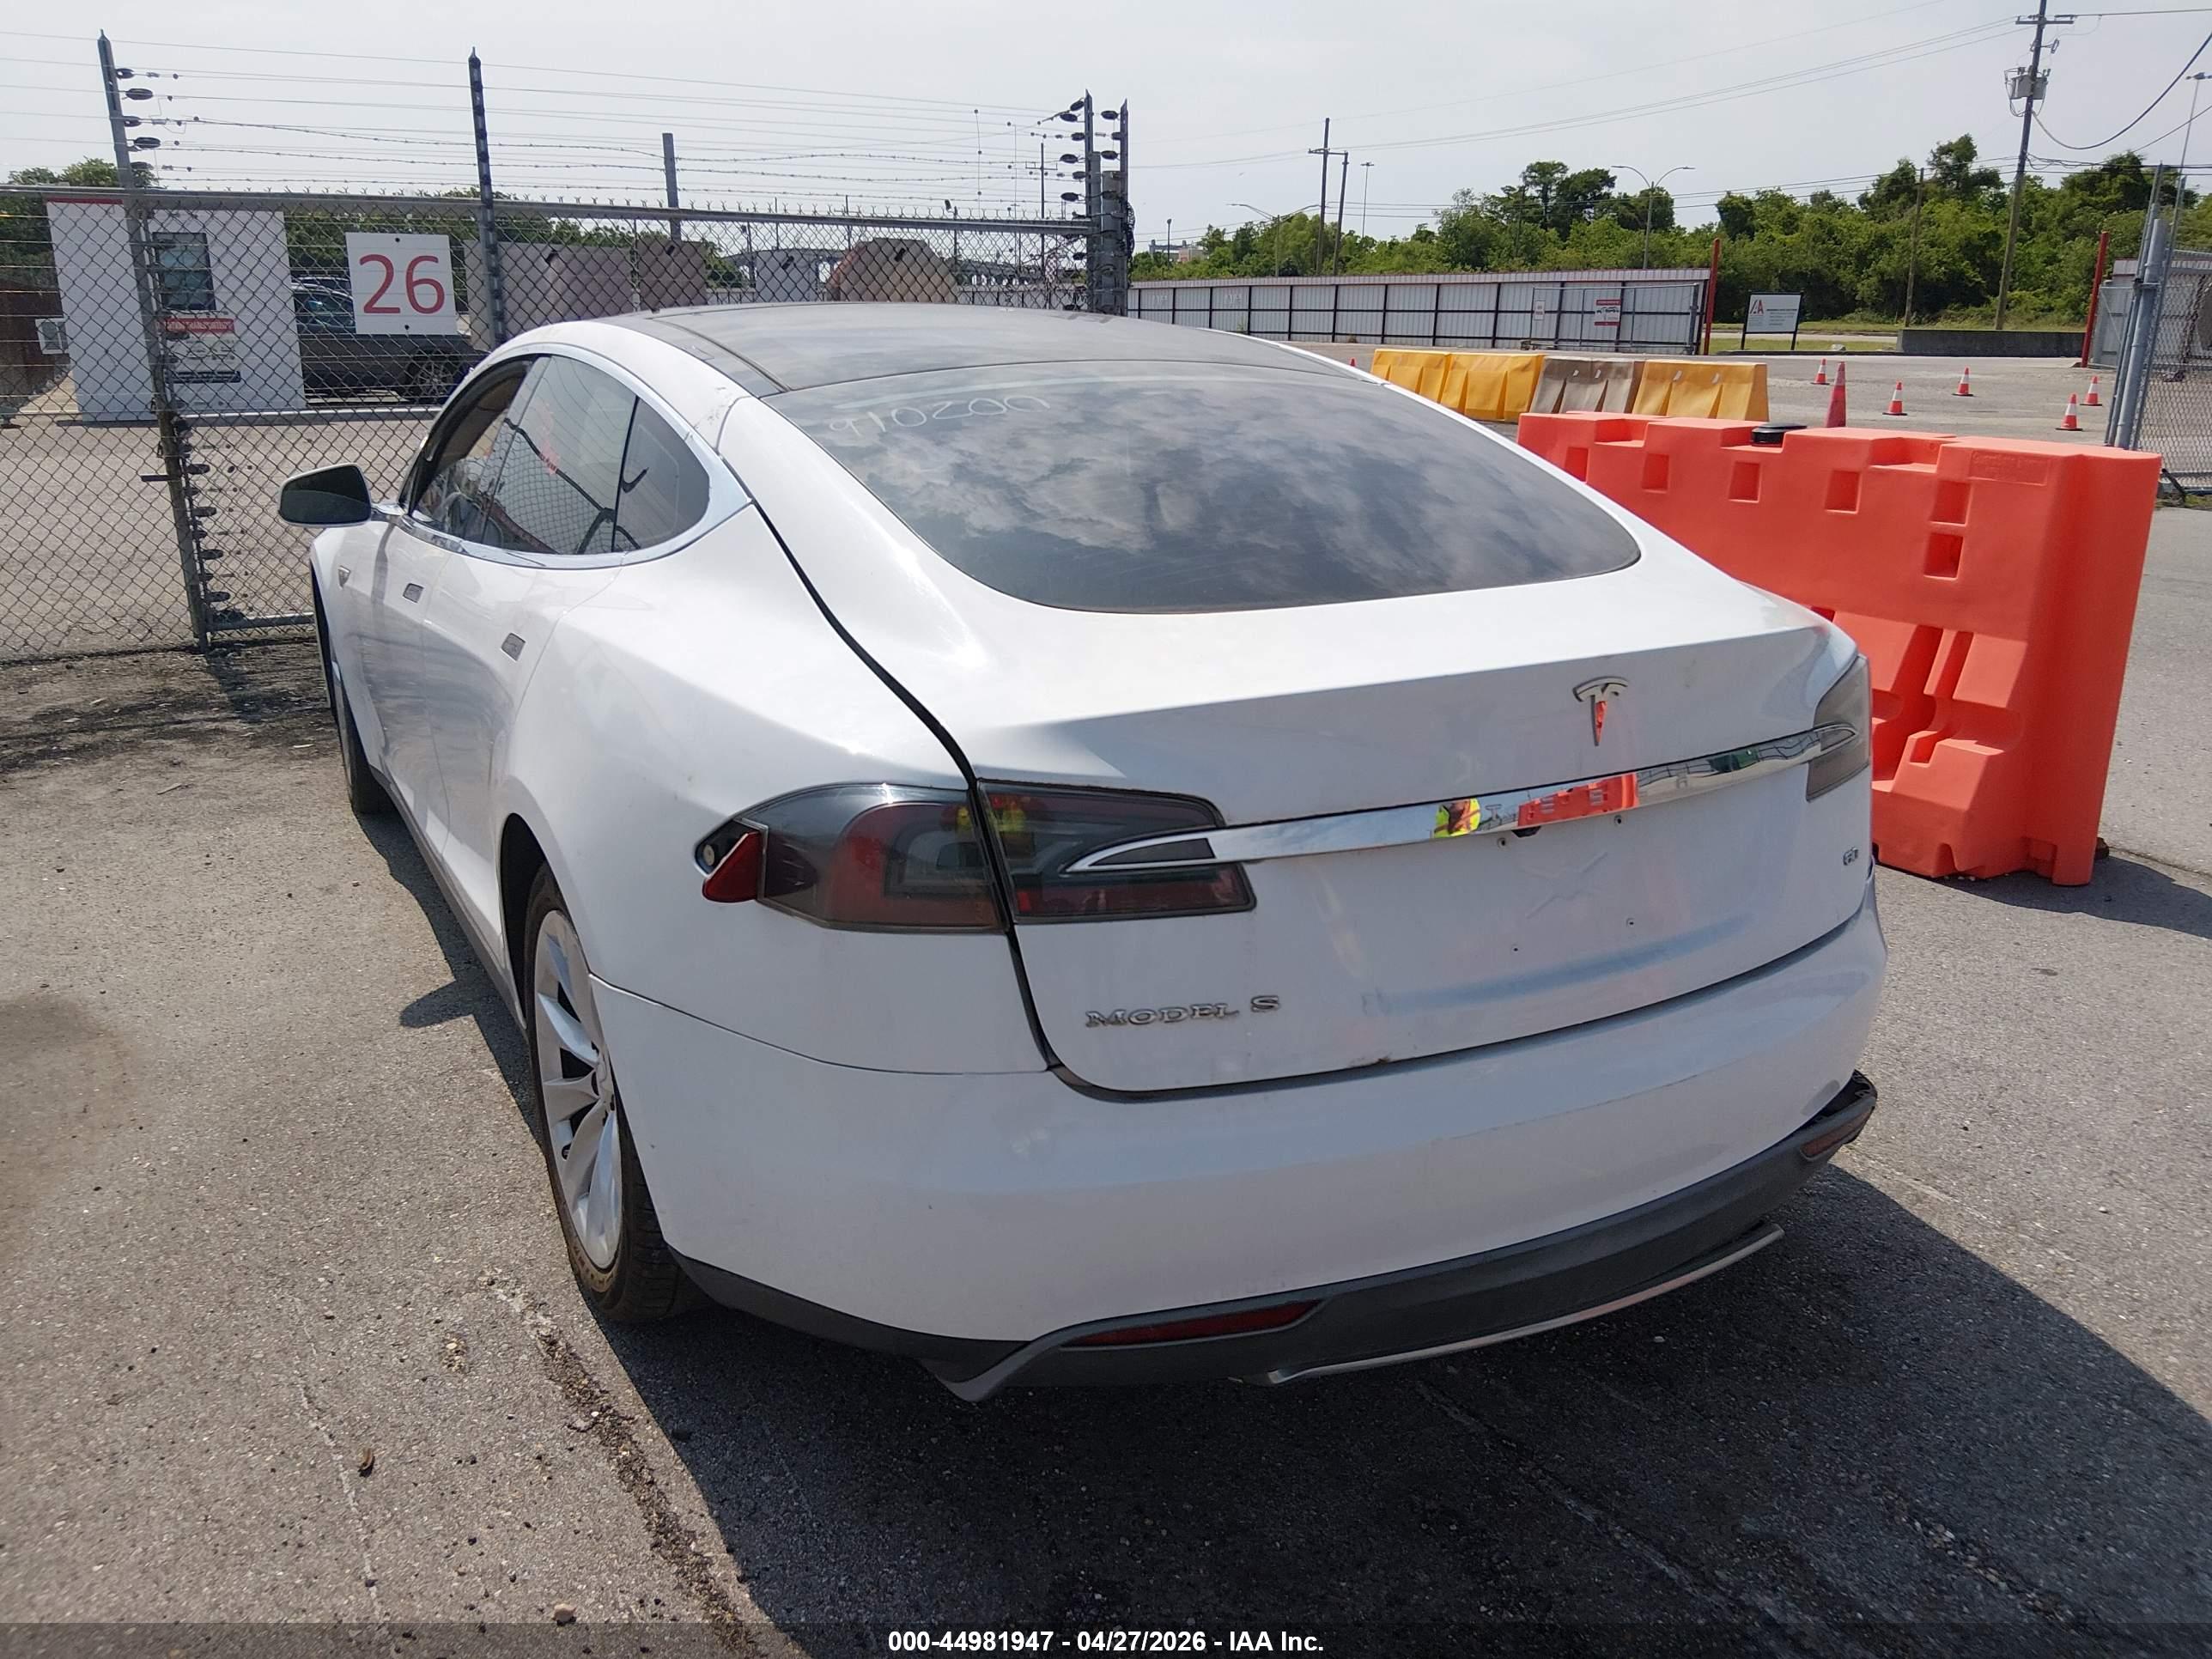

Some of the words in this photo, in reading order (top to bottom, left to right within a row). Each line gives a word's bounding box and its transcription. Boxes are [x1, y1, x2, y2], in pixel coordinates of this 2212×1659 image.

[358, 253, 447, 315] 26
[1085, 1002, 1240, 1028] MODEL
[1249, 994, 1281, 1012] S
